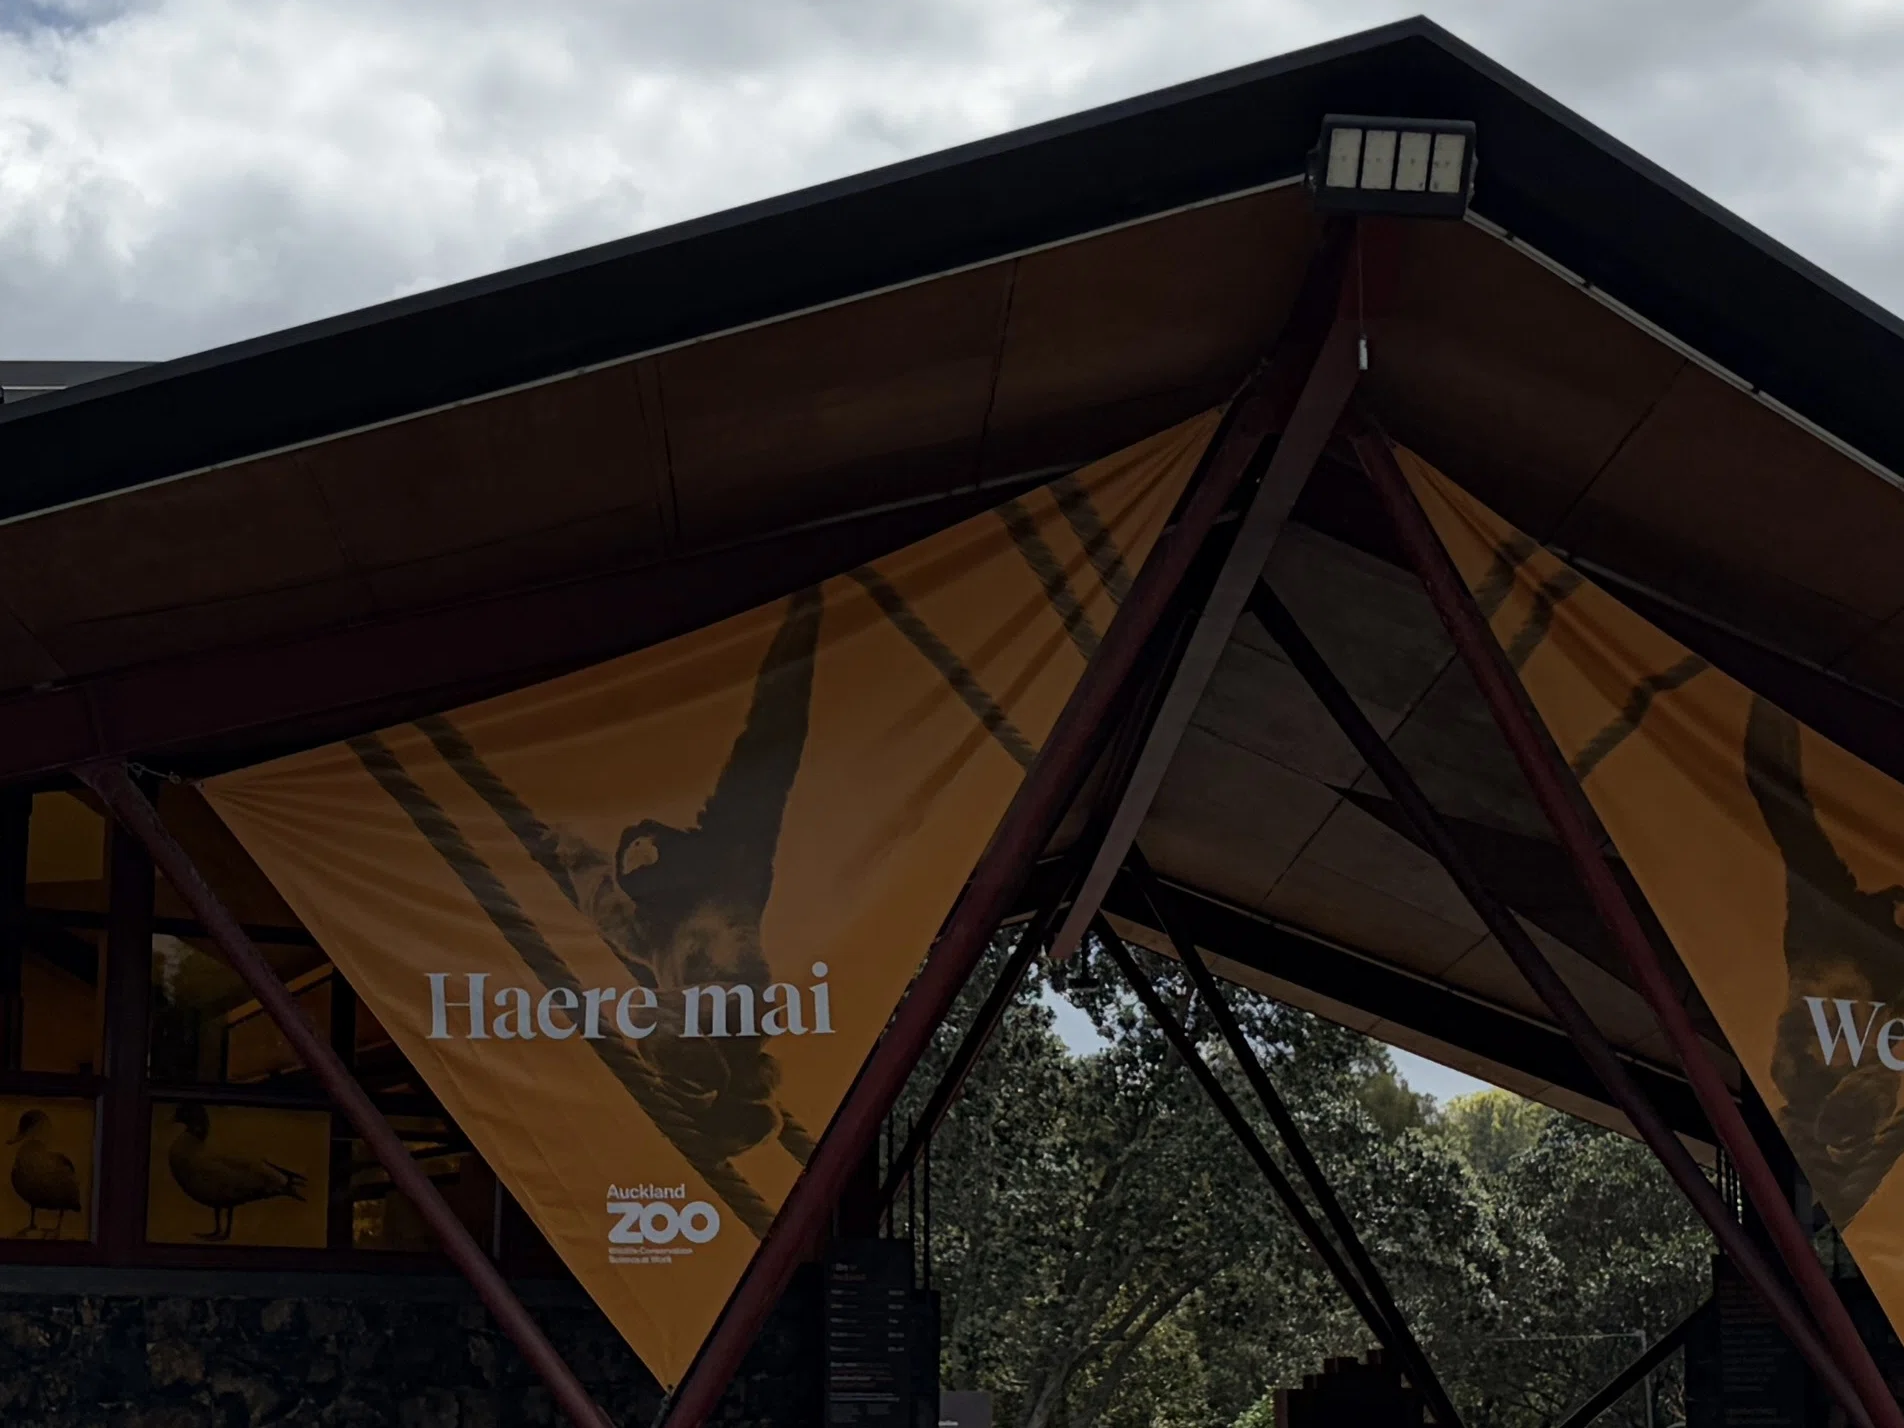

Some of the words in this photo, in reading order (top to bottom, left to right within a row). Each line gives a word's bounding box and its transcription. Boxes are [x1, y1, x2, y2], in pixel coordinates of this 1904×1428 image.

[424, 971, 660, 1040] Haere
[677, 961, 836, 1038] mai
[606, 1183, 686, 1200] Auckland
